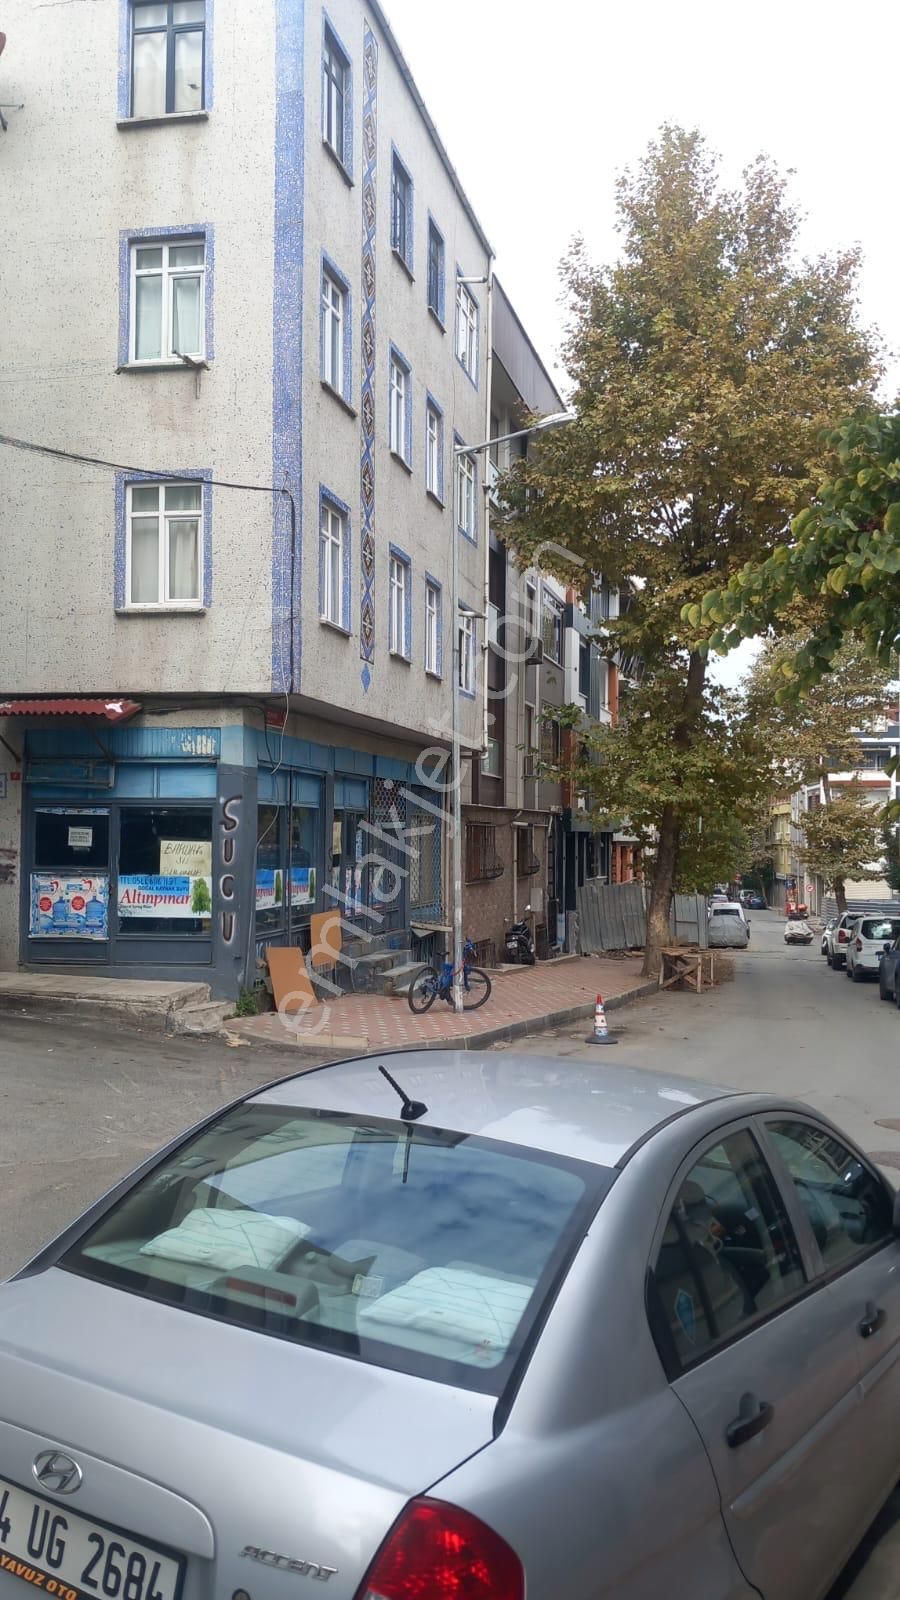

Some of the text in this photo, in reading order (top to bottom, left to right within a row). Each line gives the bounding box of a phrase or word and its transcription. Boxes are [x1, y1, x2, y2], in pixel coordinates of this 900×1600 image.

[120, 888, 192, 907] Altınpınar
[220, 794, 243, 945] SUCU
[0, 1554, 78, 1600] YAVUZ OTO
[27, 1504, 69, 1569] UG
[81, 1532, 164, 1600] 2684
